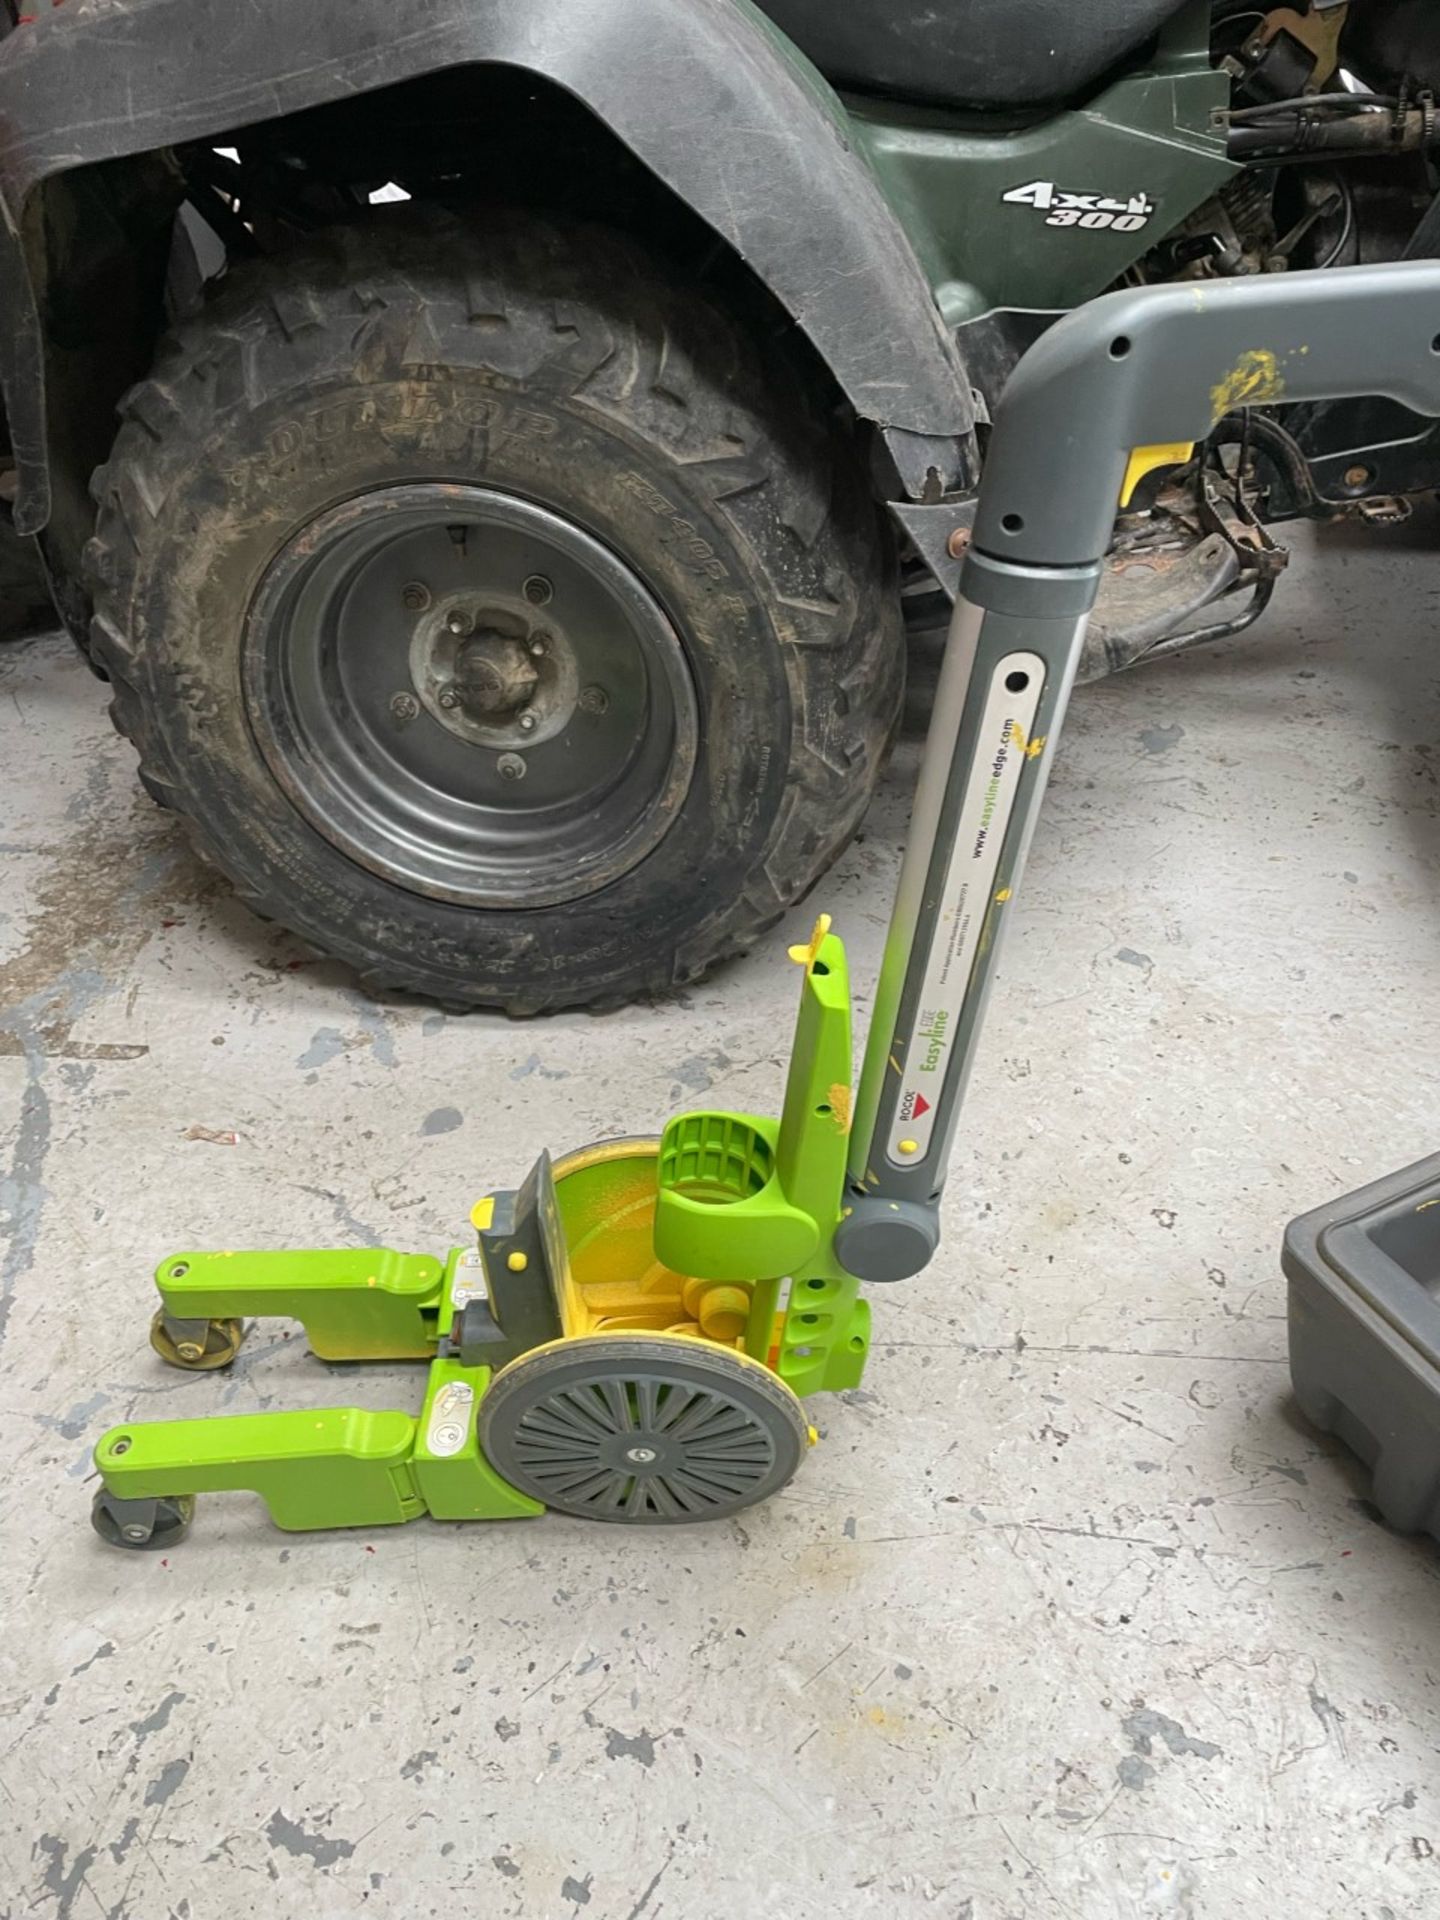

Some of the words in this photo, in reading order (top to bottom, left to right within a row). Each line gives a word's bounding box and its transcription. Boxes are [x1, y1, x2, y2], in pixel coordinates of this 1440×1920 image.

[1045, 209, 1148, 231] 300
[265, 393, 558, 466] DUNLOP
[973, 718, 1014, 859] www.easylineedge.com
[918, 1010, 949, 1072] Easyline
[899, 1090, 916, 1121] ROCOL
